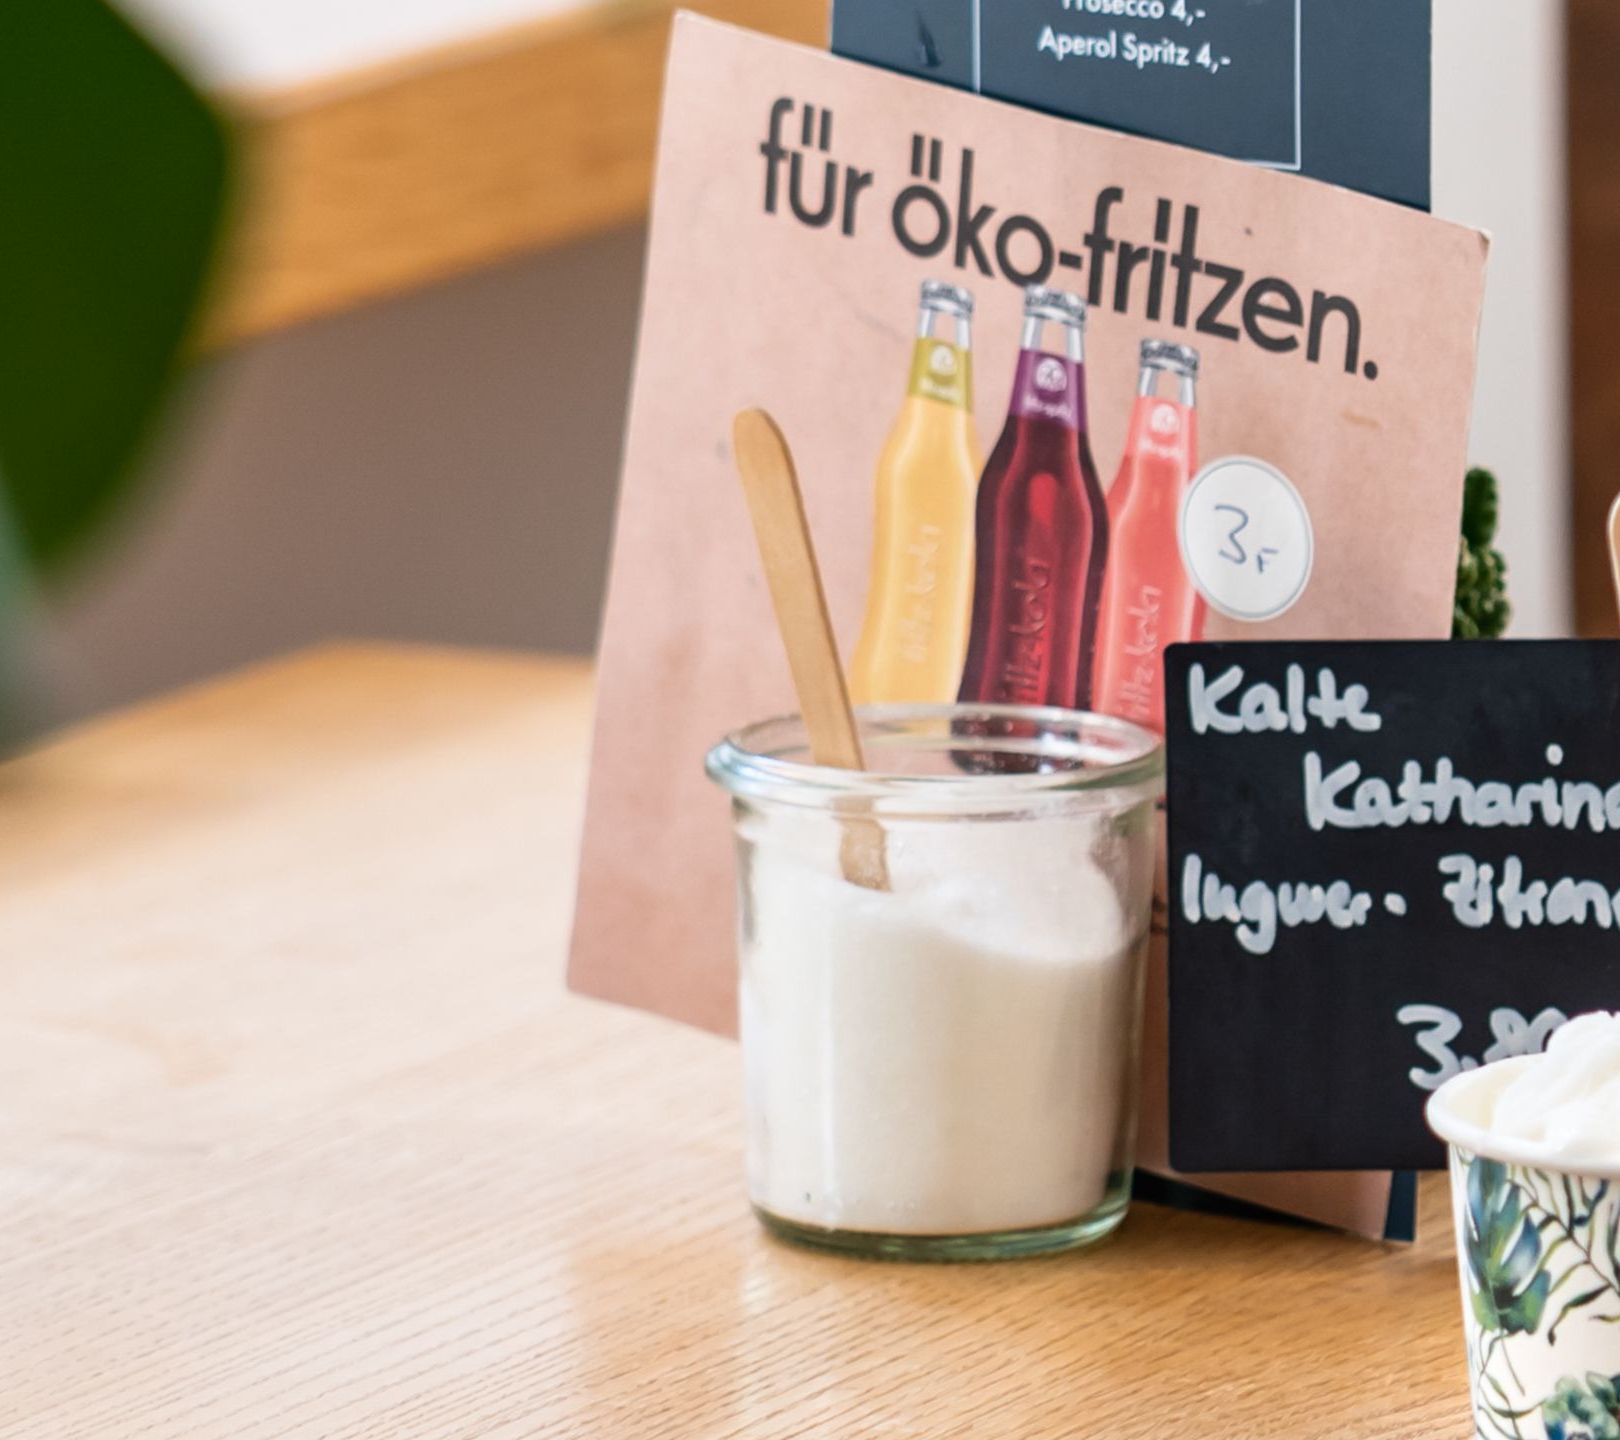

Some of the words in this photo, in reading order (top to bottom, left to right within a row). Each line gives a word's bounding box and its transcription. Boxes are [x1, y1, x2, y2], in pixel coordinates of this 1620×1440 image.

[1037, 24, 1117, 61] Aperol
[1122, 32, 1190, 70] Spritz
[1195, 42, 1231, 75] 4,-
[760, 97, 874, 238] für
[890, 133, 1378, 382] öko-fritzen.
[1188, 662, 1382, 734] Kalte
